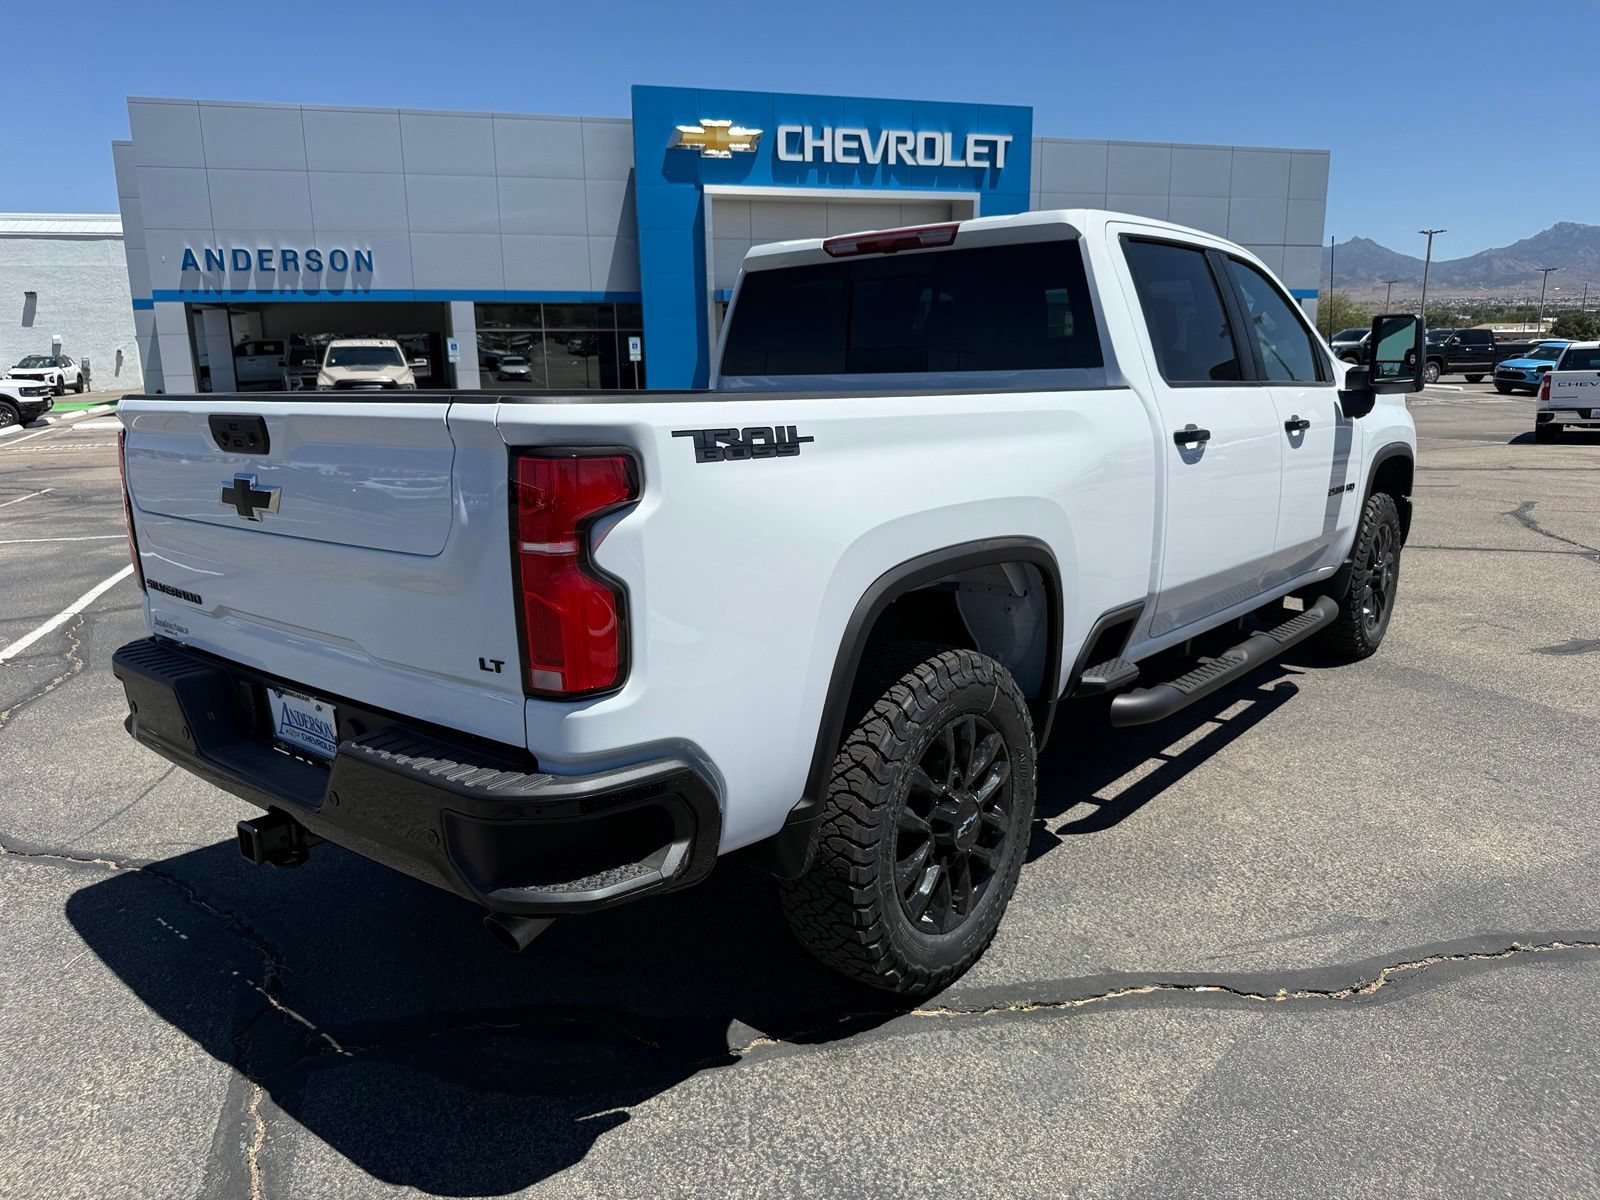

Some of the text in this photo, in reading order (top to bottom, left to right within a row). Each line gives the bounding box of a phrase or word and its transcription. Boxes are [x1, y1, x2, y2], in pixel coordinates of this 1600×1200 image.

[777, 125, 1013, 169] CHEVROLET
[181, 248, 374, 273] ANDERSON
[671, 425, 815, 448] TRAIL
[695, 443, 801, 463] BOSS
[146, 578, 202, 605] SILVERADO
[478, 657, 505, 673] LT
[279, 702, 337, 741] ANDERSON
[301, 732, 337, 754] CHEVROLET
